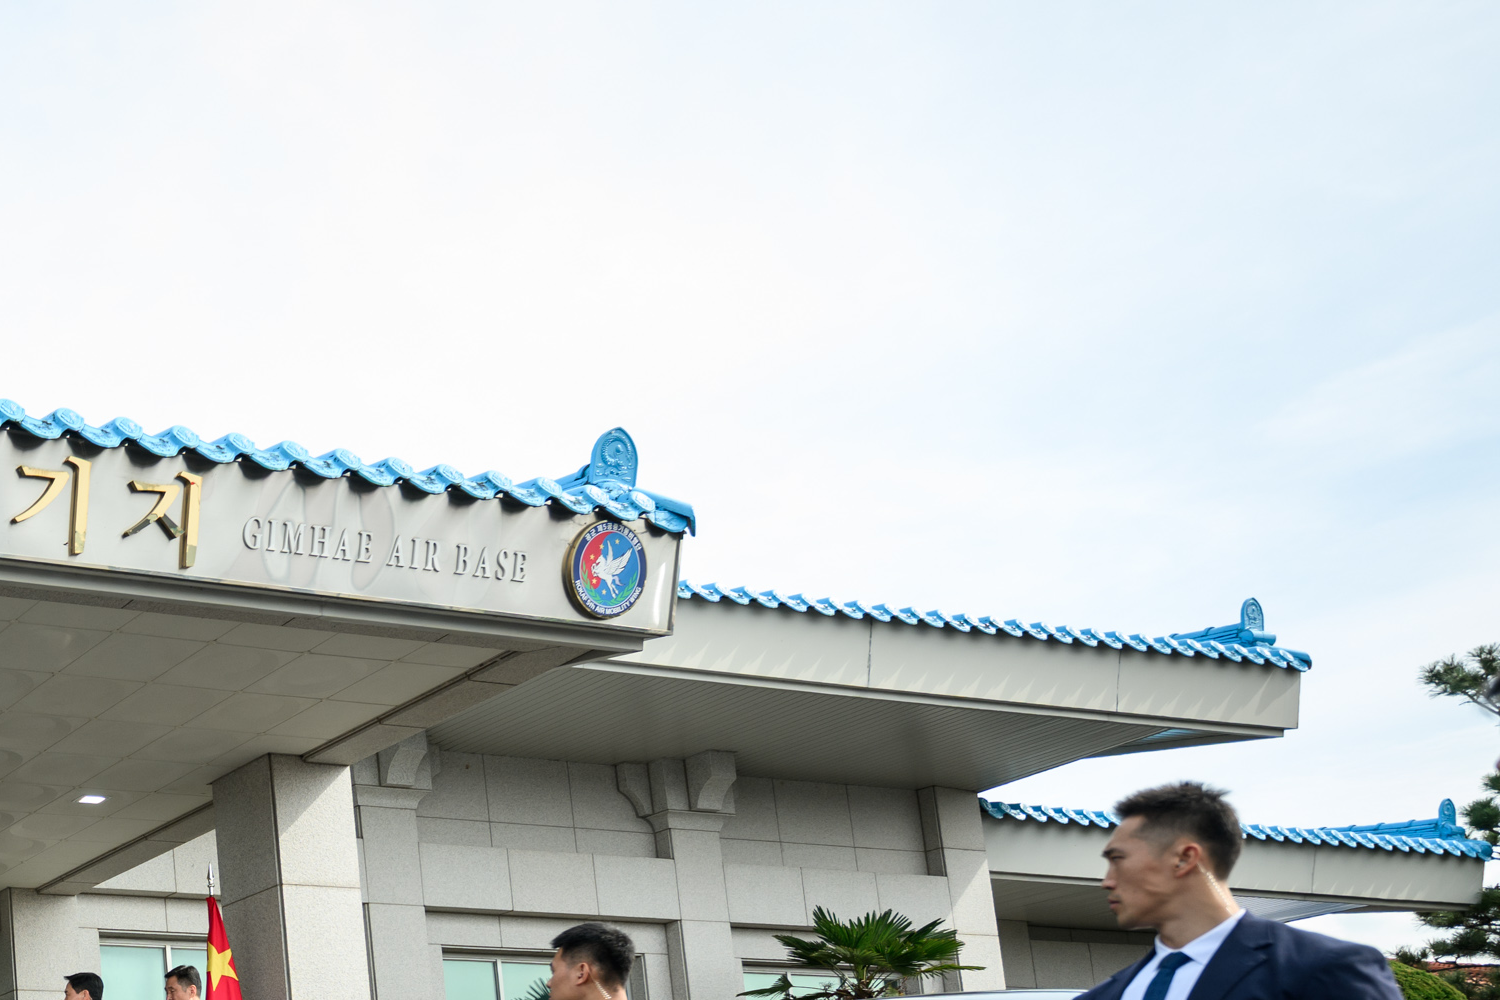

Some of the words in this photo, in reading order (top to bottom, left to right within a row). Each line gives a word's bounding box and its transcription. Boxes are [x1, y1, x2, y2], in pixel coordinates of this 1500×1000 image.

[242, 516, 374, 564] GIMHAE
[386, 535, 440, 573] AIR
[454, 543, 528, 583] BASE
[575, 579, 588, 602] ROKAF
[595, 606, 605, 614] AIR
[605, 602, 631, 615] MOBILITY
[630, 586, 642, 603] WING
